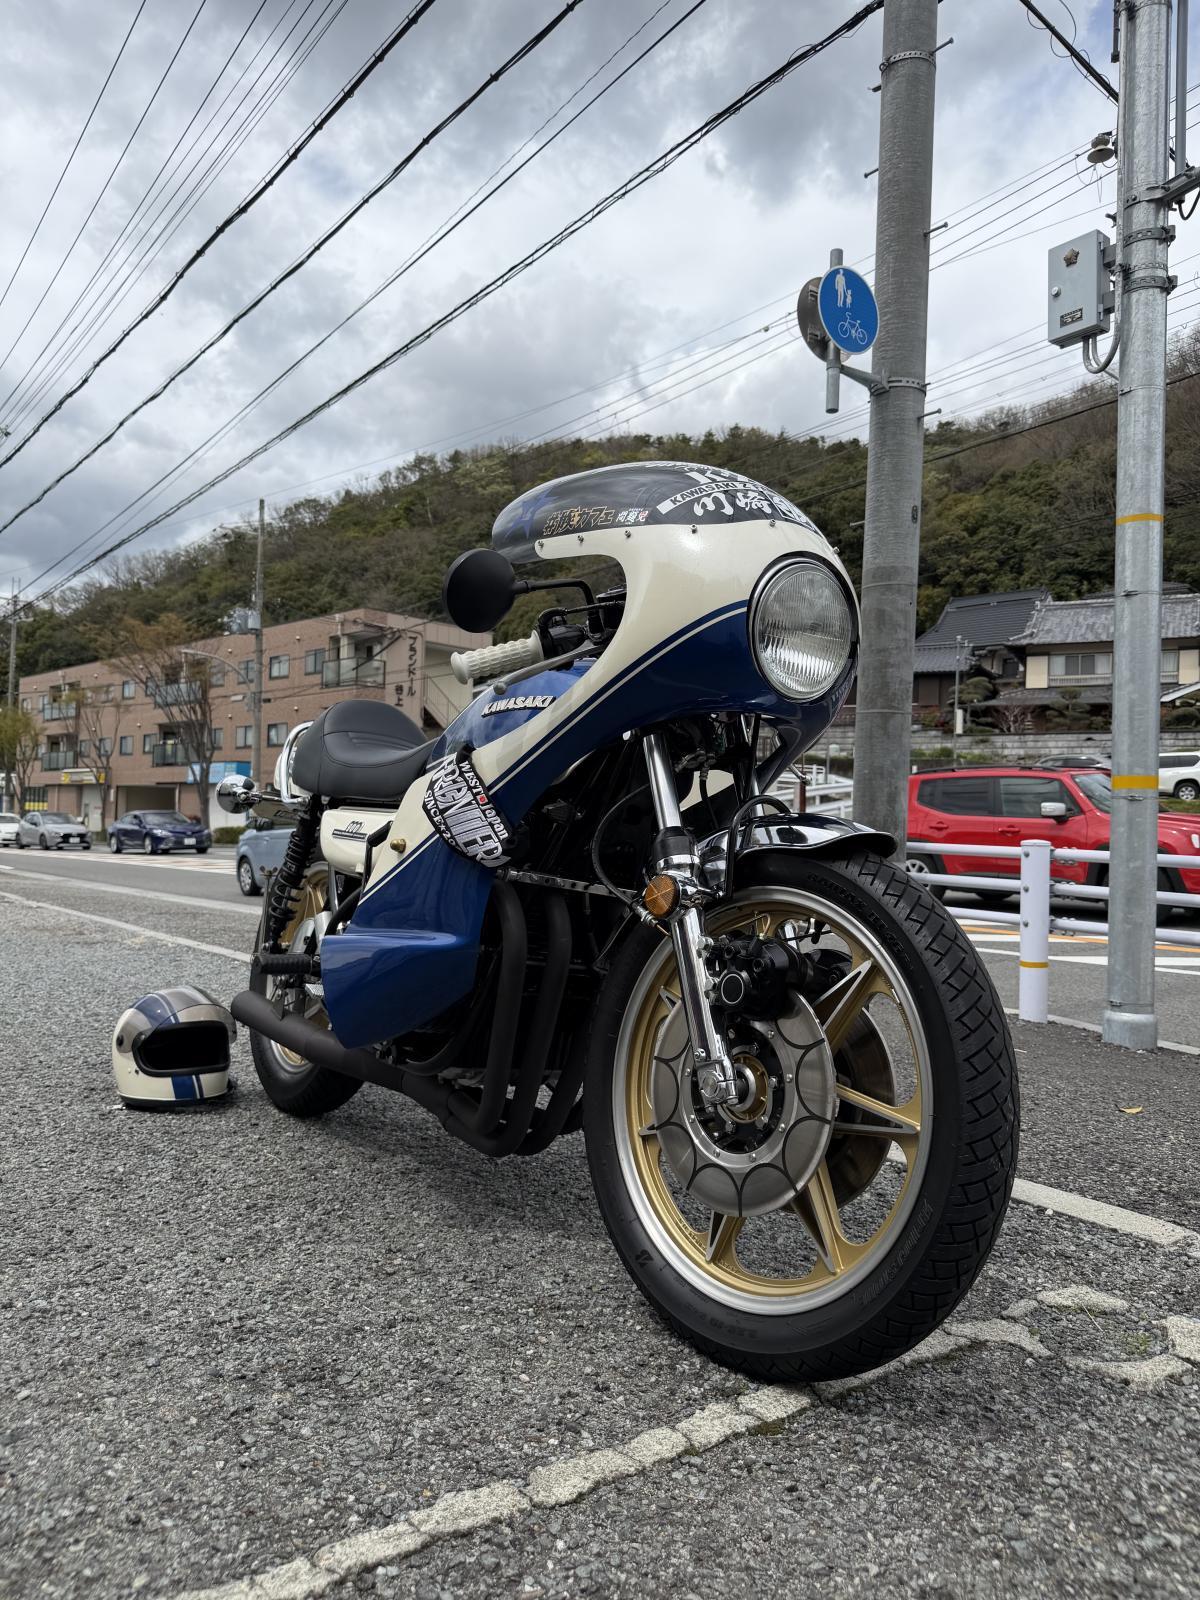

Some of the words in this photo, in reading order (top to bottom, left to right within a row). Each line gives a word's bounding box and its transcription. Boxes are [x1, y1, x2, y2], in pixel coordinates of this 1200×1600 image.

[670, 482, 738, 505] KAWASAKI
[481, 695, 554, 716] KAWASAKI
[424, 790, 444, 825] SINCE
[459, 760, 484, 793] WEST
[480, 803, 509, 840] Japan
